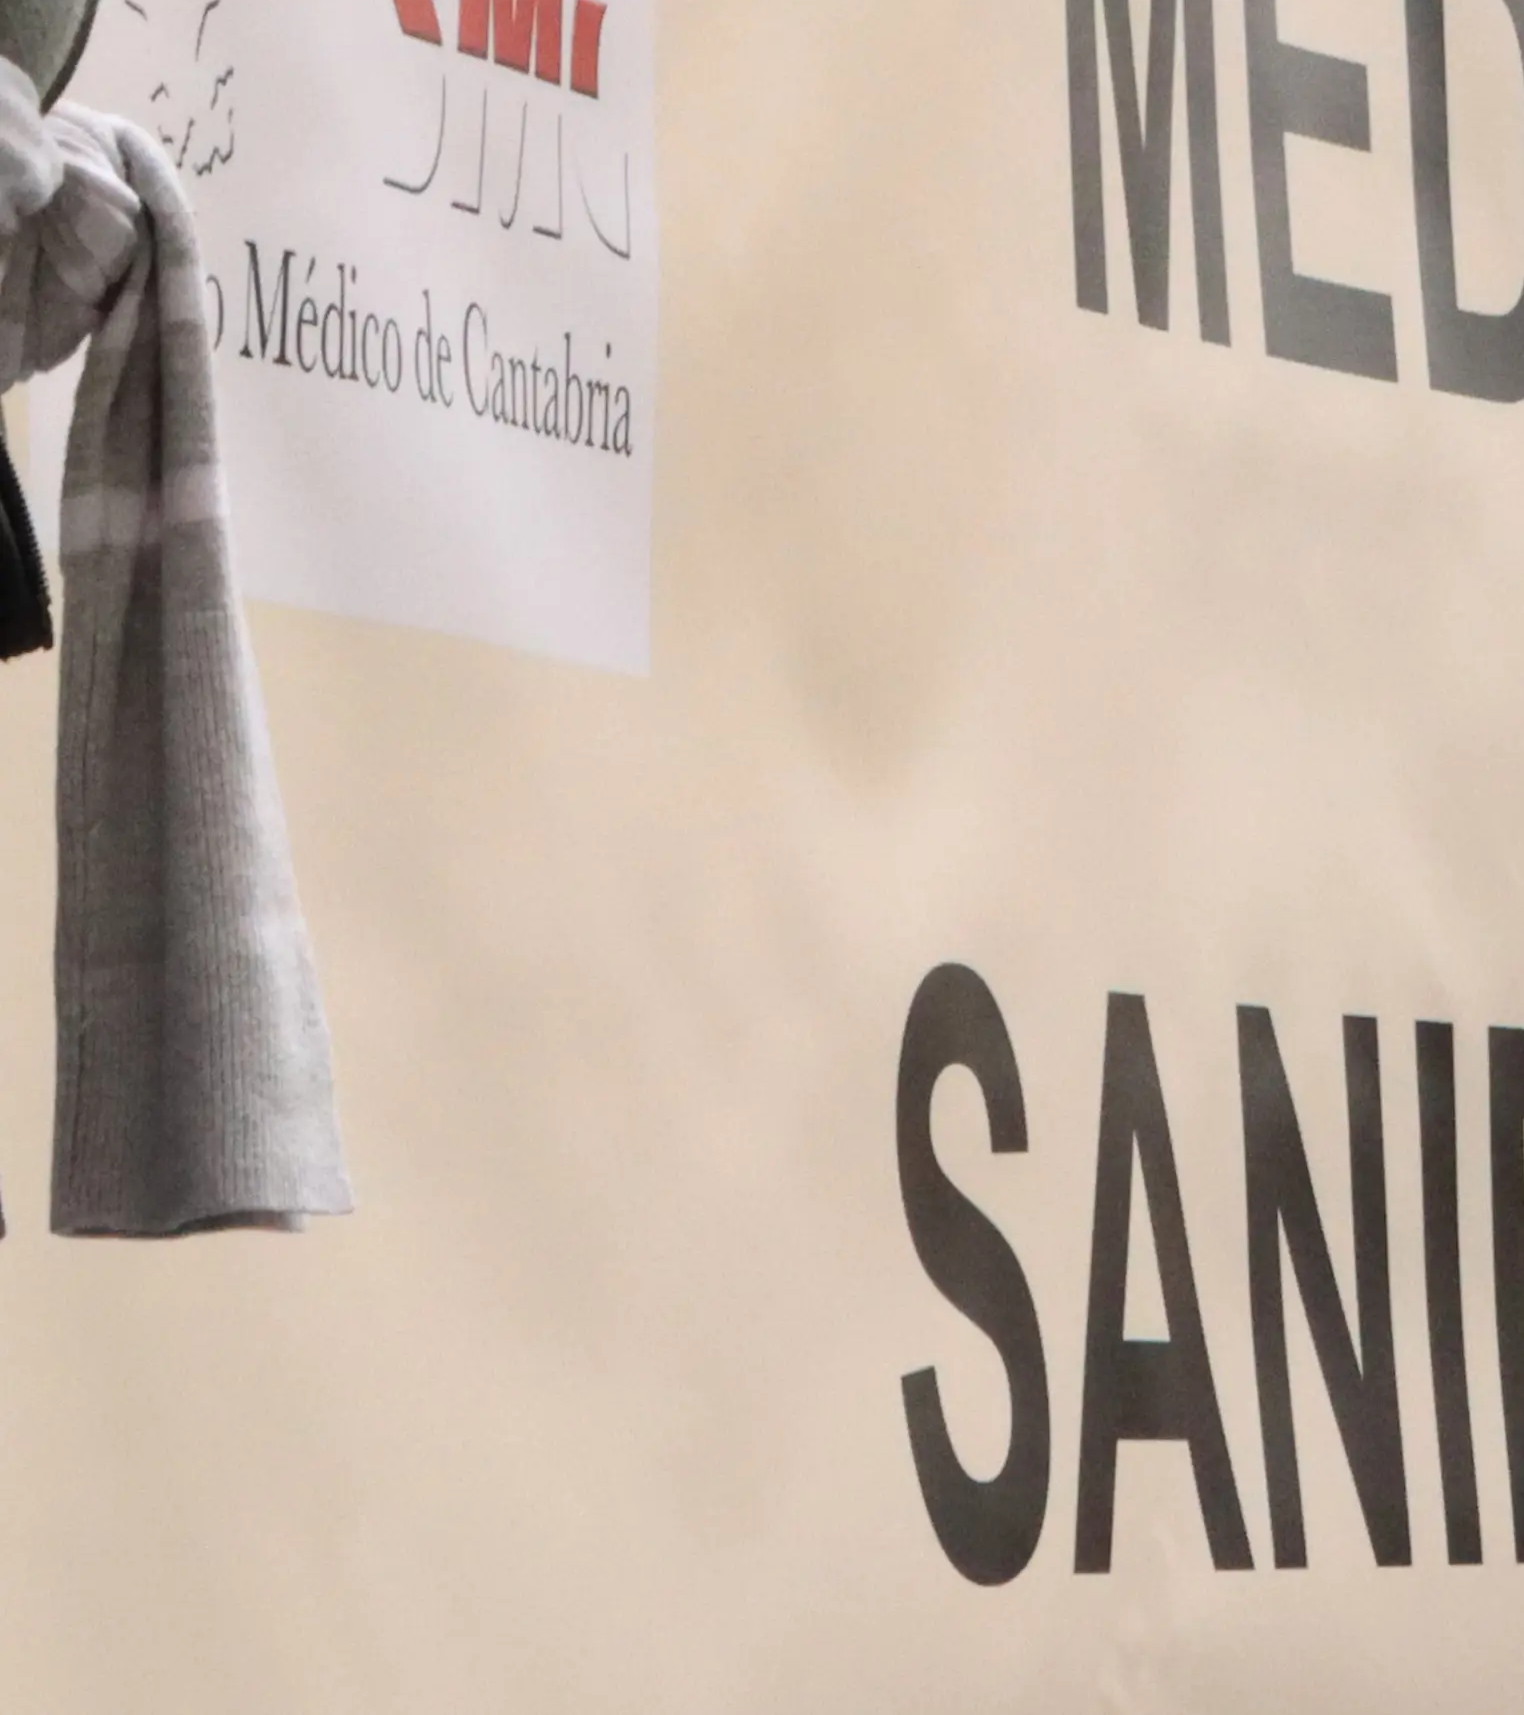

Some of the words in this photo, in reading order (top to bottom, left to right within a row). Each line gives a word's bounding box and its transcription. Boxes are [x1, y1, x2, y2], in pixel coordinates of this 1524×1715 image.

[239, 239, 403, 393] Médico
[413, 288, 453, 409] de
[462, 301, 634, 458] Cantabria
